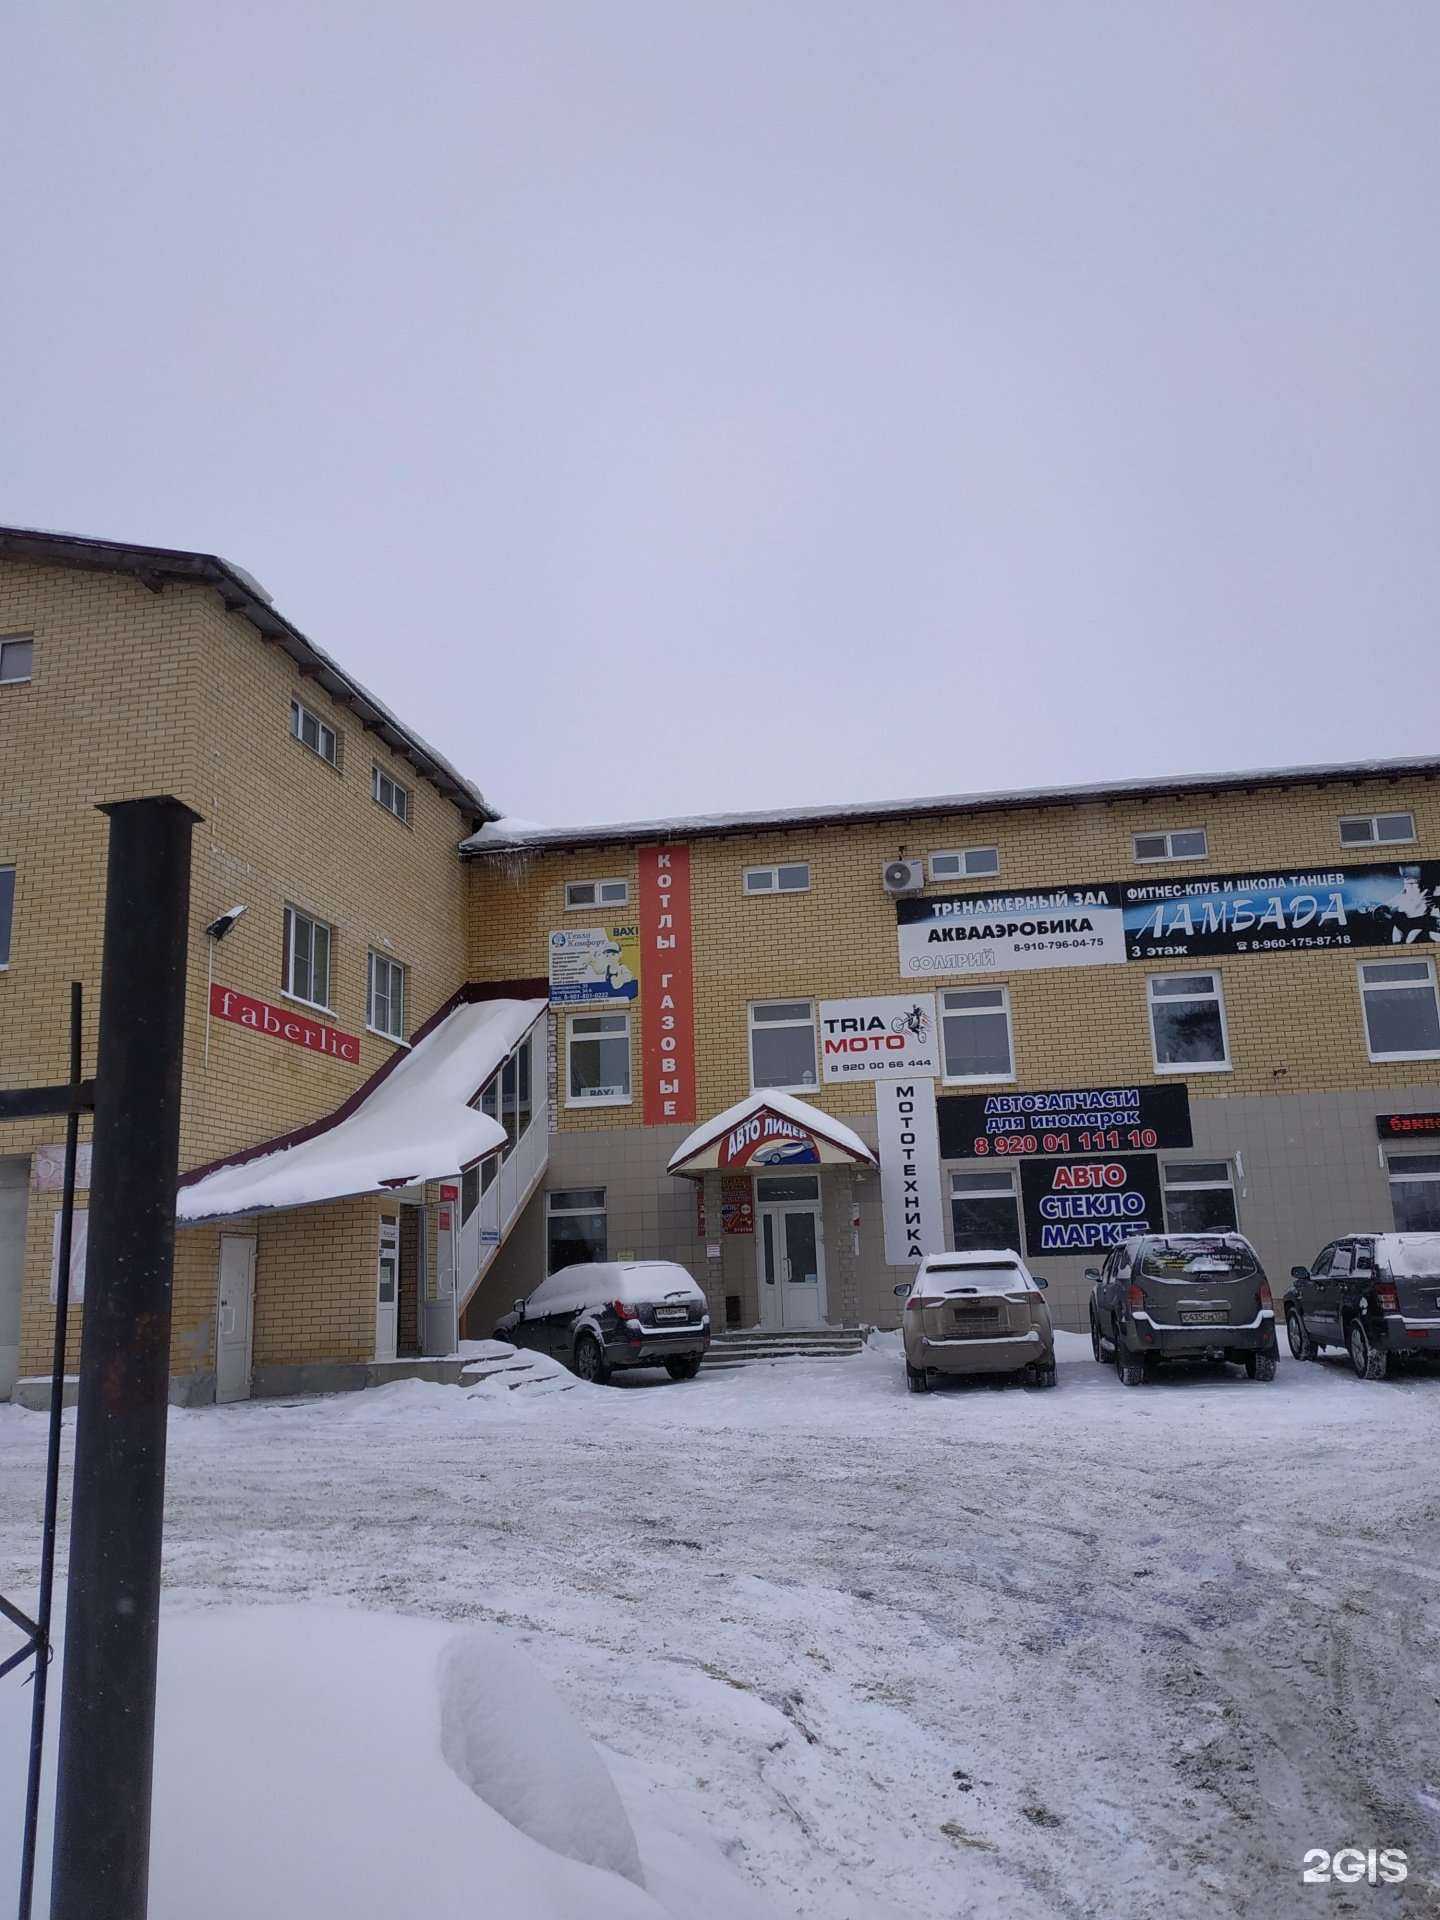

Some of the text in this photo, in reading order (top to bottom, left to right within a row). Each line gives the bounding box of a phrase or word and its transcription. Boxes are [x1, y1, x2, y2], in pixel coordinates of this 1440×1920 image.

[1126, 873, 1346, 900] ФИТНЕС-КЛУБ И ШКОЛА ТАНЦЕВ
[656, 854, 676, 949] КОТЛЫ
[932, 891, 1110, 917] ТРЕНАЖЕРНЫЙ ЗАЛ
[612, 926, 638, 936] BAXI
[927, 917, 1094, 943] АКВААЭРОБИКА
[1251, 935, 1351, 950] 8-960-175-87-18
[1013, 937, 1104, 952] 8-910-796-04-75
[1130, 943, 1188, 957] 3 этаж
[908, 948, 996, 971] СОЛЯРИЙ
[221, 992, 353, 1059] faberlic
[823, 1016, 886, 1033] TRIA
[659, 974, 679, 1116] ГАЗОВЫЕ
[842, 1063, 865, 1071] 920
[869, 1062, 884, 1070] 00
[908, 1059, 931, 1067] 444
[984, 1089, 1140, 1114] АВТОЗАПЧАСТИ
[986, 1110, 1141, 1133] для иномарок
[728, 1119, 760, 1162] АВТО
[974, 1128, 1157, 1155] 8 920 01 111 10
[896, 1086, 923, 1257] МОТОТЕХНИКА
[1052, 1163, 1127, 1189] АВТО
[1039, 1192, 1146, 1219] СТЕКЛО
